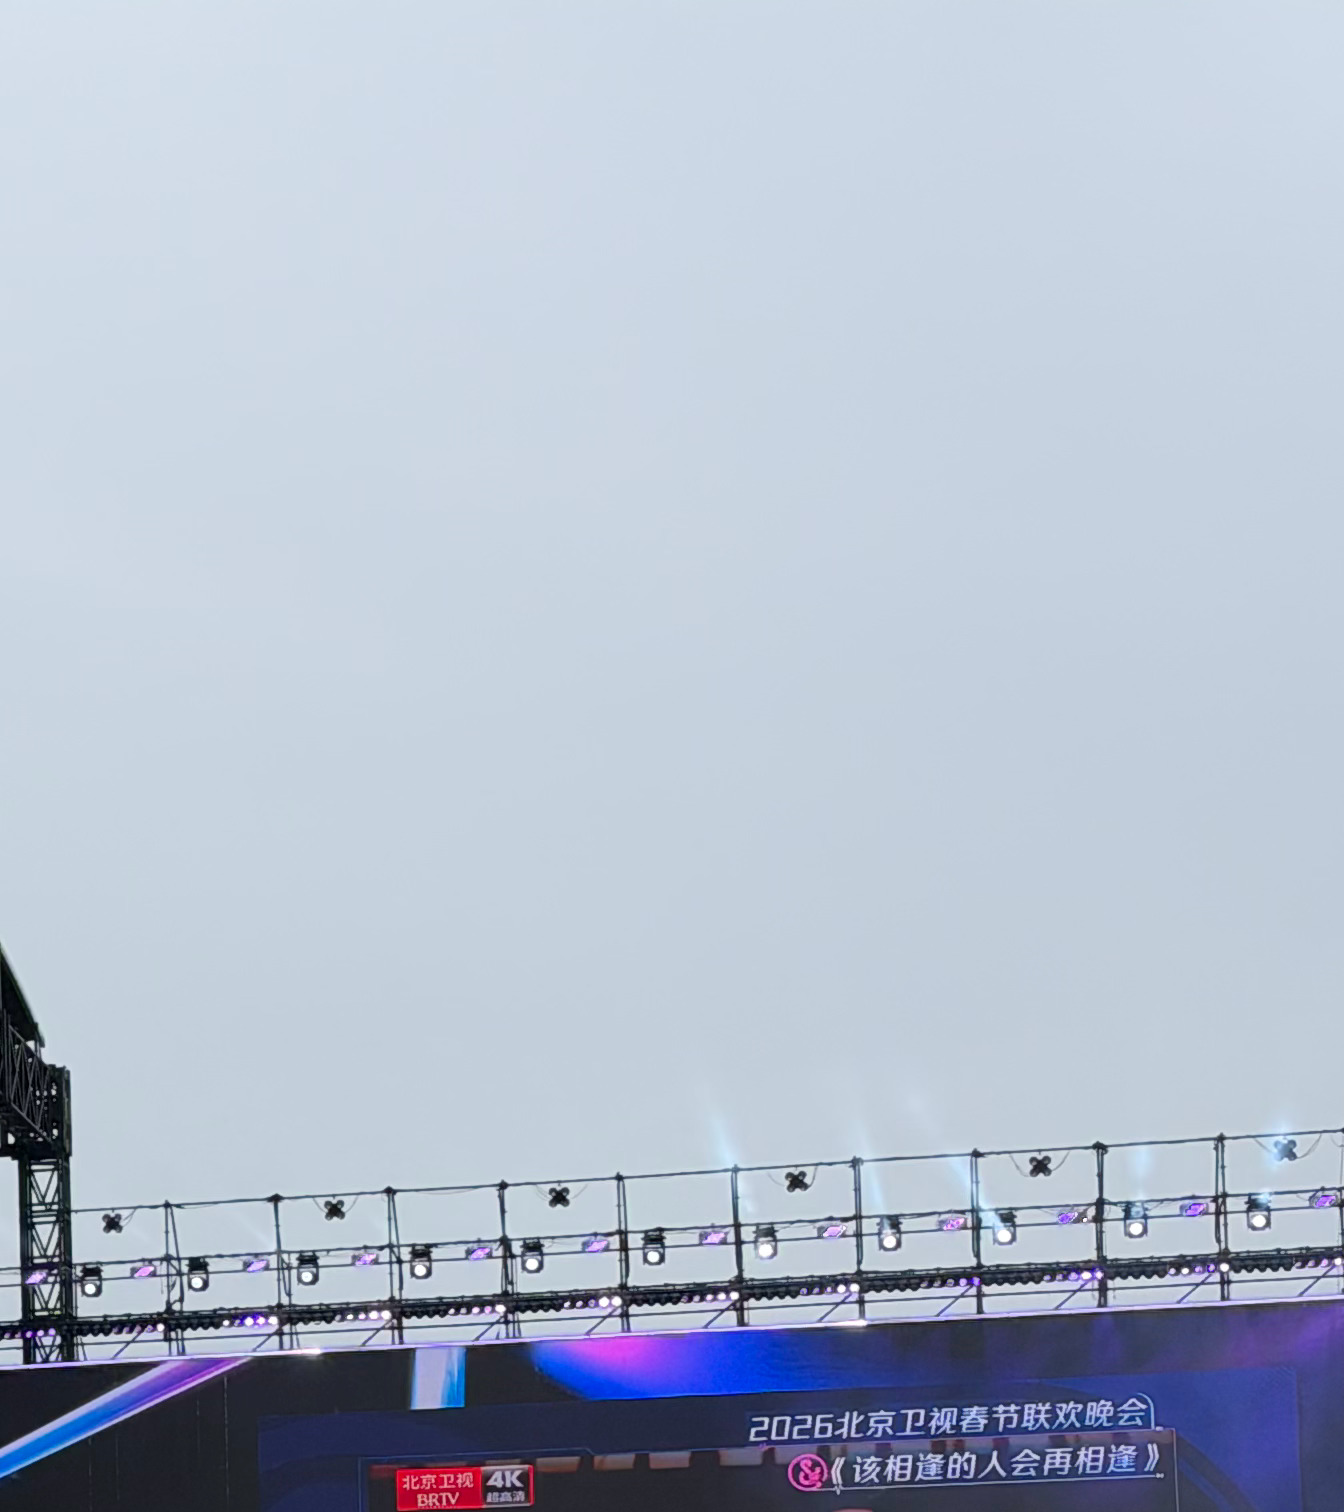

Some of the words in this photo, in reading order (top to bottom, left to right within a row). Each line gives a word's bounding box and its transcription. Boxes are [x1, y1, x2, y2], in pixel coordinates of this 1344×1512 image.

[749, 1397, 1148, 1442] 2026北京卫视春节联欢晚会
[831, 1443, 1160, 1488] 《该相逢的人会再相逢》
[402, 1472, 474, 1490] 北京卫视
[486, 1470, 524, 1488] 4K
[417, 1492, 459, 1507] BRTV
